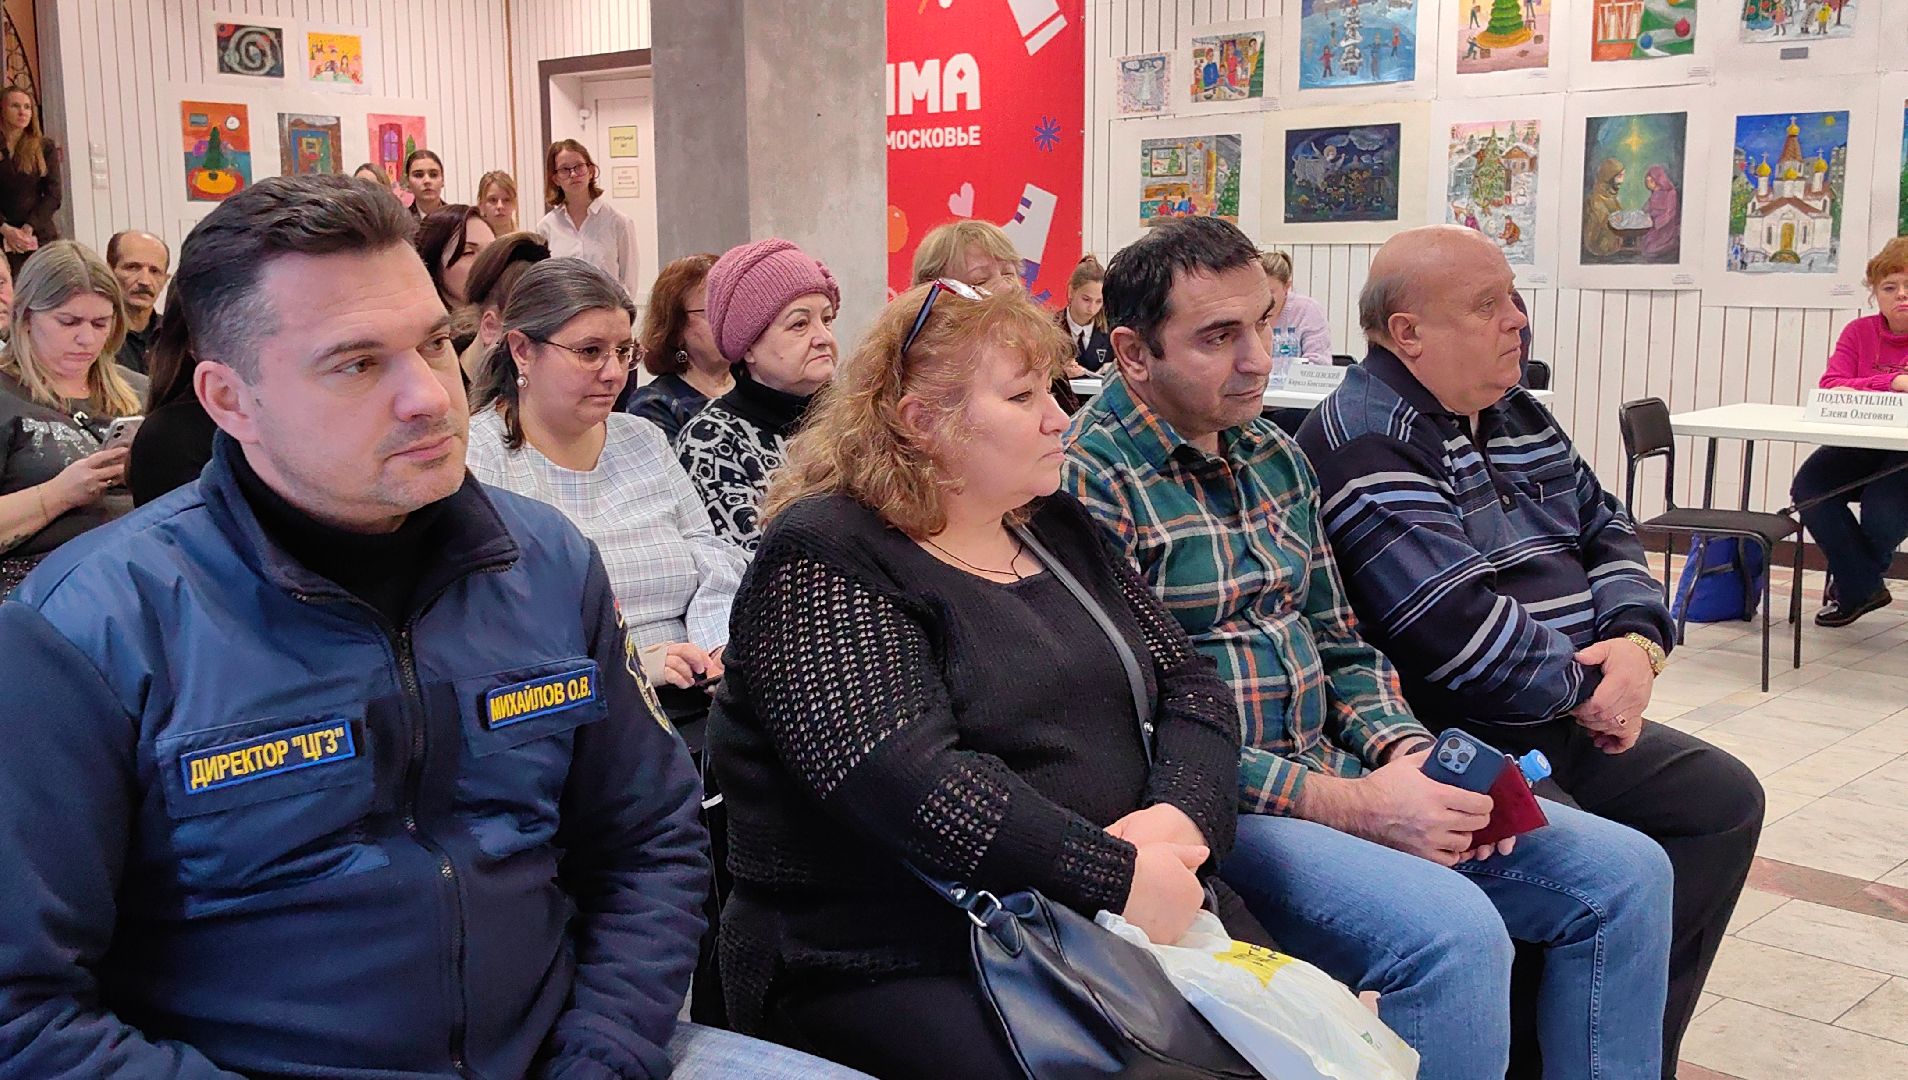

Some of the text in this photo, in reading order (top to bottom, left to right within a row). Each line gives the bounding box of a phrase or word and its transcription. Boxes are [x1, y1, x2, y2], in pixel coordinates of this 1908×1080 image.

[1817, 393, 1903, 406] ПОДХВАТИЛИНА
[1821, 407, 1894, 420] Елена Олеговна
[490, 677, 591, 721] МИХАЙЛОВ О.В.
[190, 727, 345, 790] ДИРЕКТОР "ЦГЗ"
